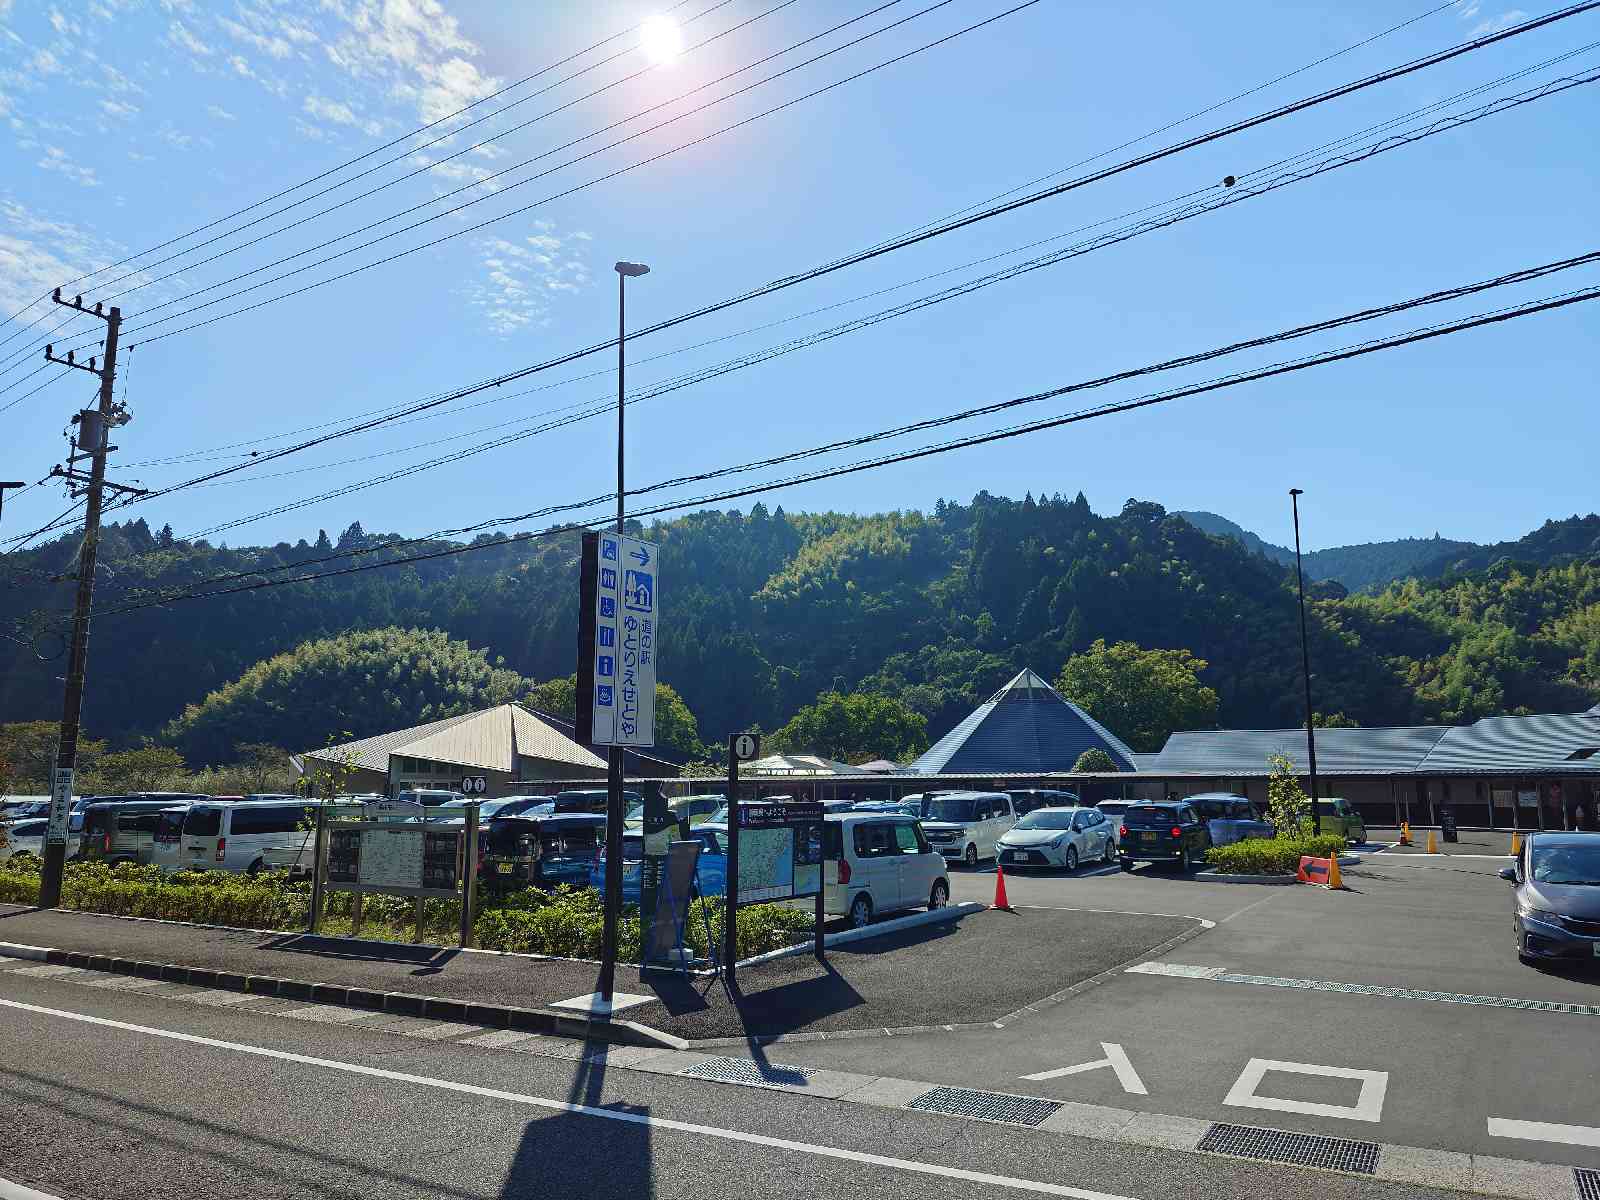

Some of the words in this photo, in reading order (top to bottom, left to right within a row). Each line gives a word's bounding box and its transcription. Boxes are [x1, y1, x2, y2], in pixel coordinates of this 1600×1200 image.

[640, 616, 653, 665] 道の駅
[1017, 1041, 1389, 1123] 入口
